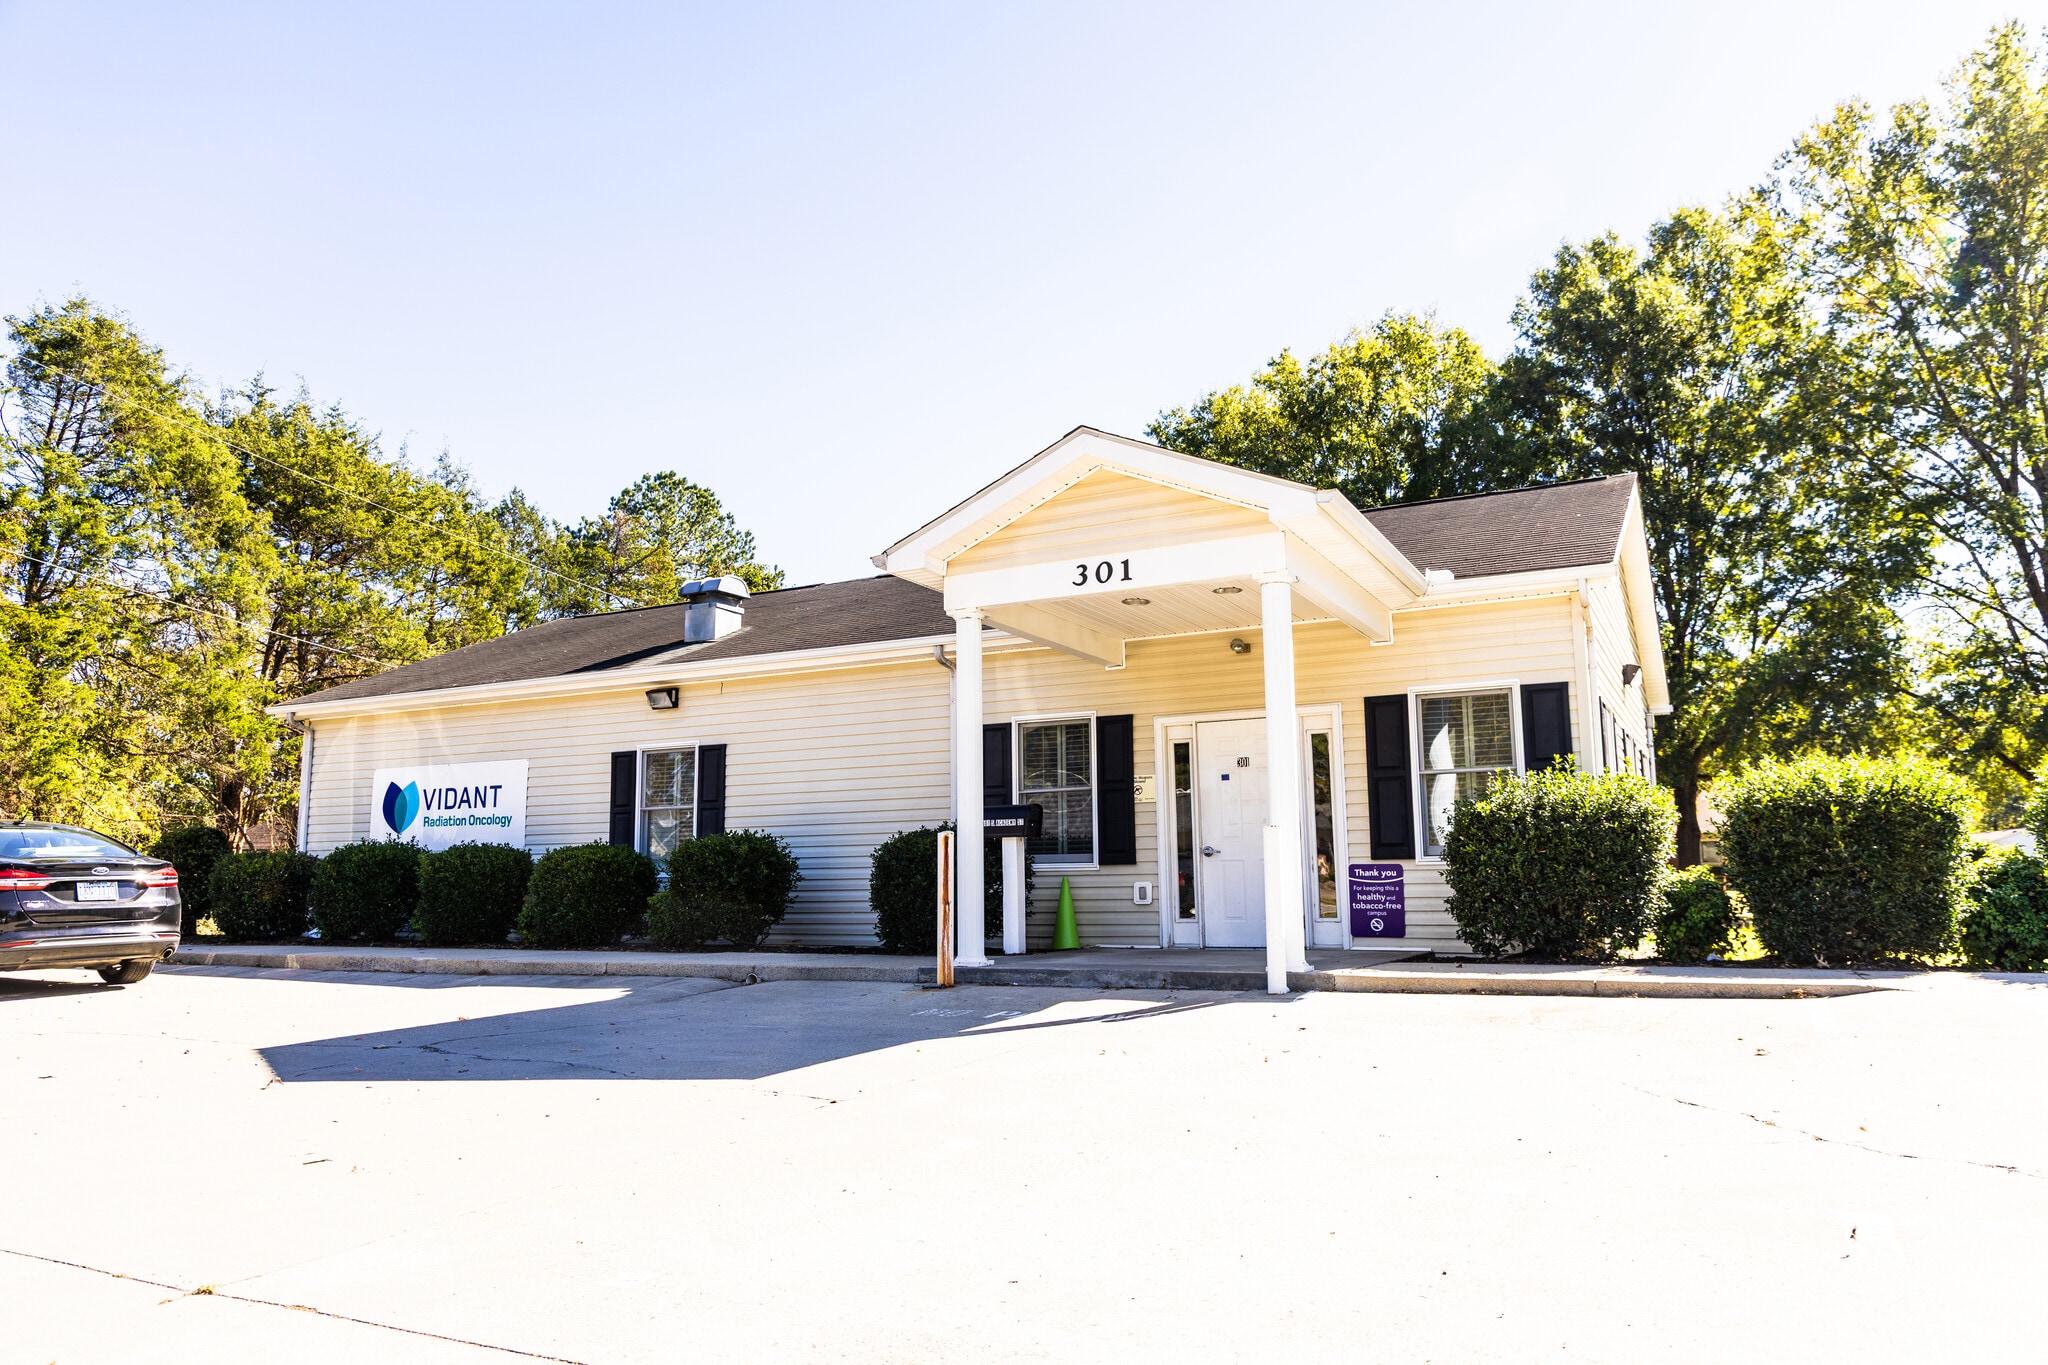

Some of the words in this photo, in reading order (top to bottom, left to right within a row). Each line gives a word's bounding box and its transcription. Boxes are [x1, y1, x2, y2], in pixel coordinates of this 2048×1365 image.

[1072, 559, 1132, 586] 301
[1237, 757, 1249, 767] 301
[423, 785, 502, 810] VIDANT
[423, 815, 467, 827] Radiation
[468, 814, 513, 827] Oncology
[1357, 893, 1385, 902] healthy
